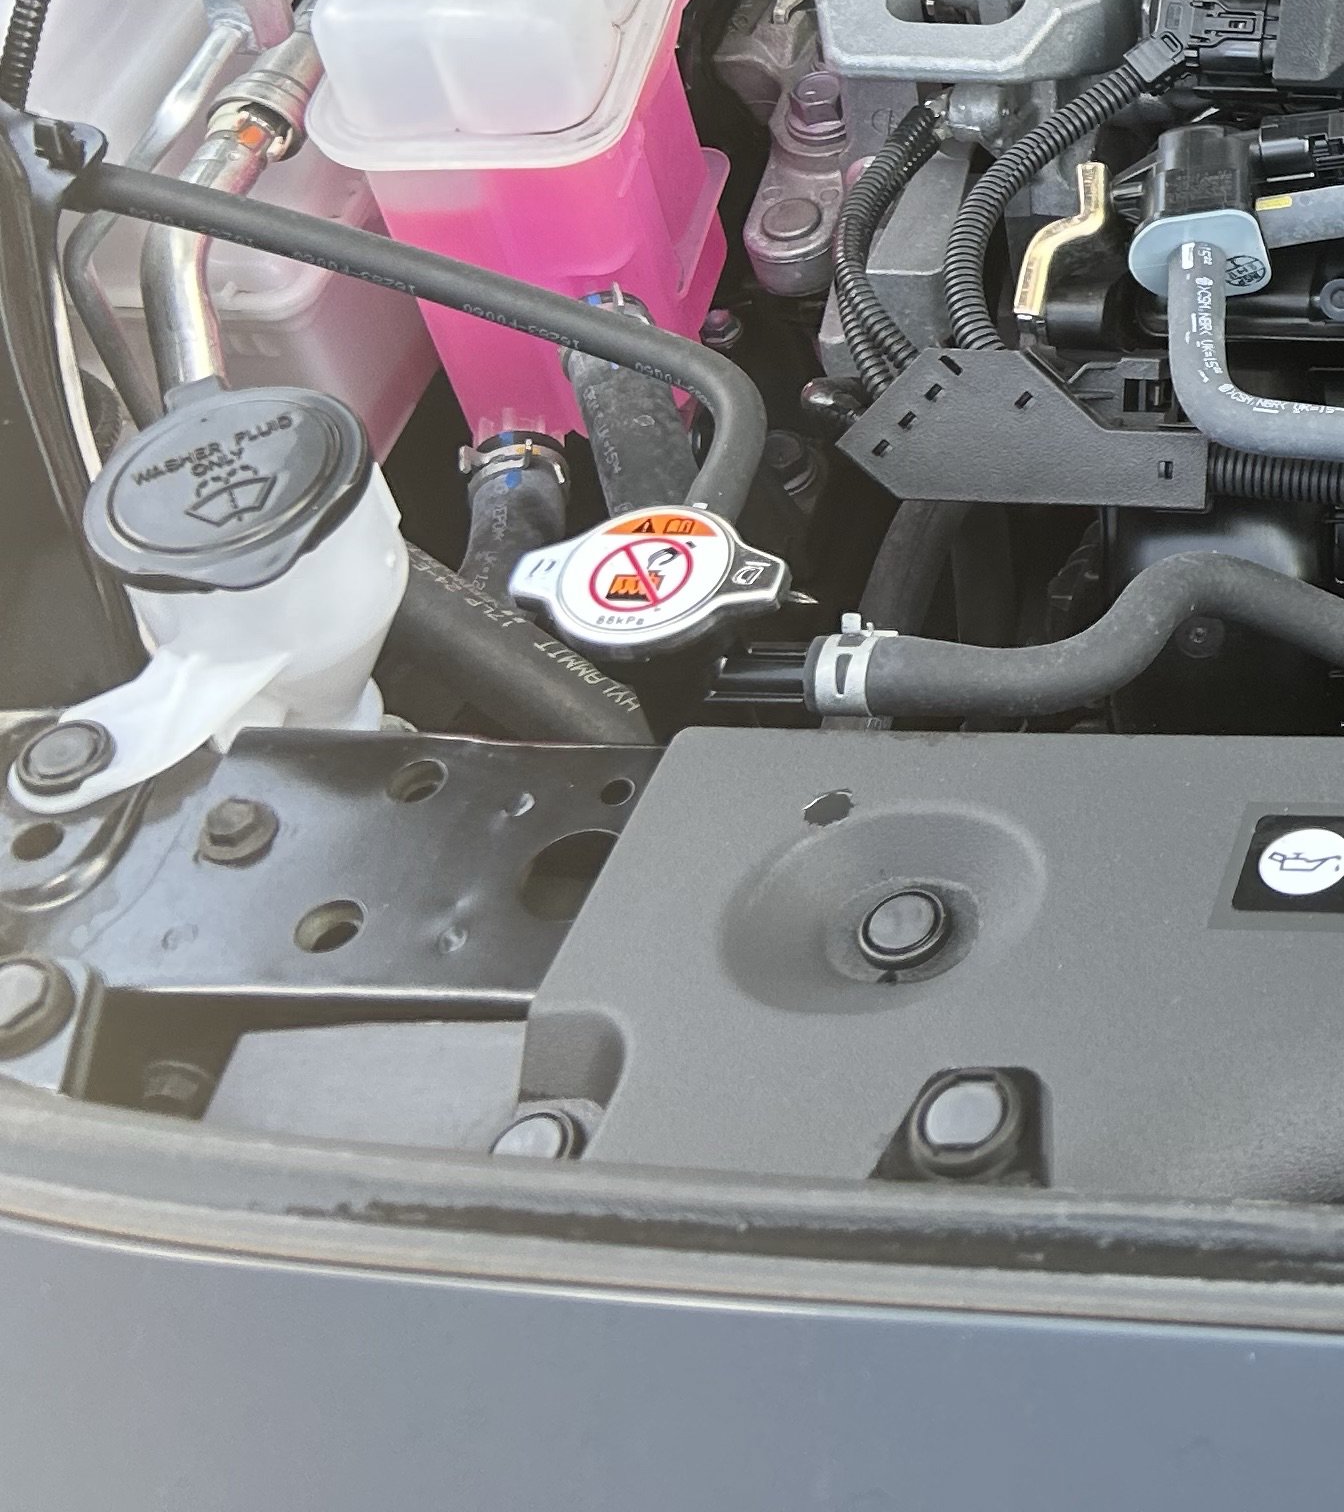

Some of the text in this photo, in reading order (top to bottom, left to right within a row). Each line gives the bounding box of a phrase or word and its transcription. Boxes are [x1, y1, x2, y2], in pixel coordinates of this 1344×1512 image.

[130, 413, 294, 487] WASHER FLUID
[190, 446, 245, 478] ONLY
